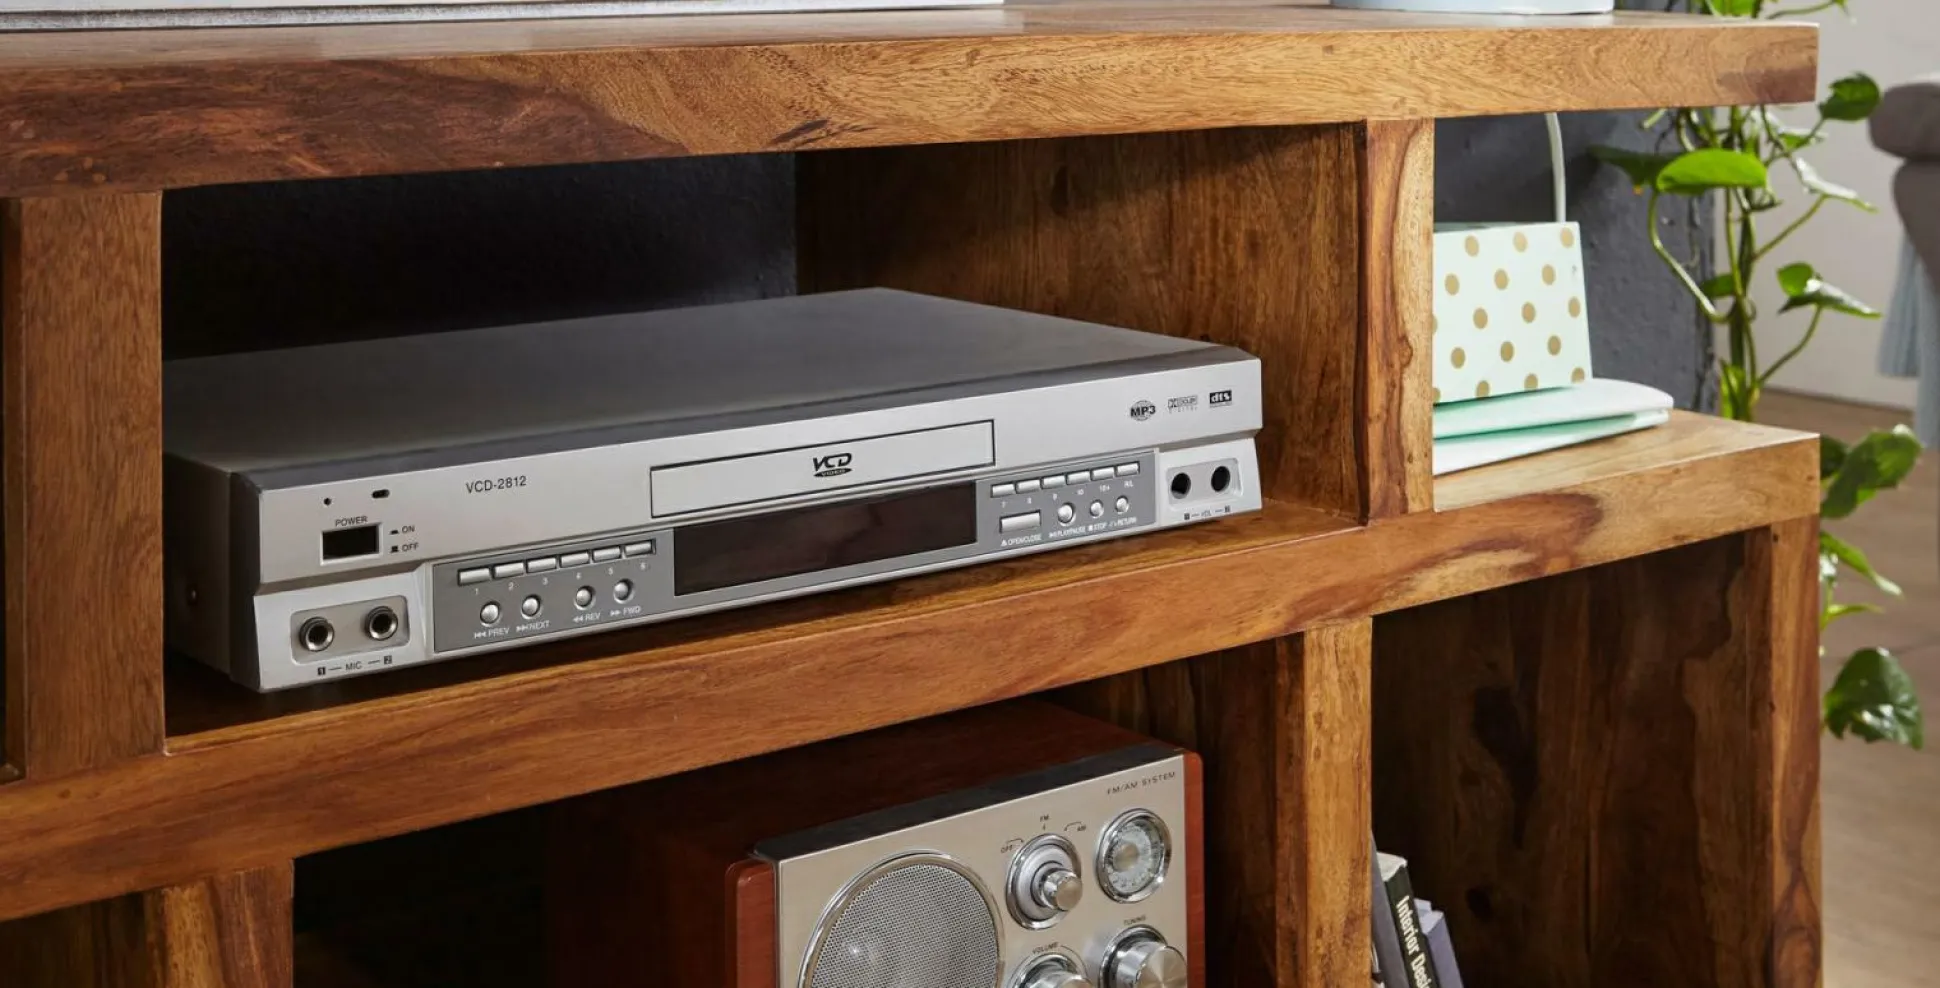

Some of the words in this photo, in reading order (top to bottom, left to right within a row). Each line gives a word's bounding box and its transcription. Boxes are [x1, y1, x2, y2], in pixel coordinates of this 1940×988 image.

[1209, 391, 1232, 403] dts
[1130, 405, 1156, 417] MP3
[813, 453, 852, 471] VCD
[465, 475, 527, 494] VCD-2812
[335, 515, 368, 527] POWER
[401, 525, 415, 533] ON
[401, 542, 419, 552] OFF
[623, 605, 641, 616] FWD
[585, 612, 600, 621] REV
[529, 620, 550, 630] NEXT
[488, 627, 510, 637] PREV
[346, 661, 362, 671] MIC
[1107, 781, 1138, 795] FM/AM
[1142, 771, 1175, 786] SYSTEM
[1396, 895, 1420, 956] Interior
[1410, 951, 1432, 988] Desi
